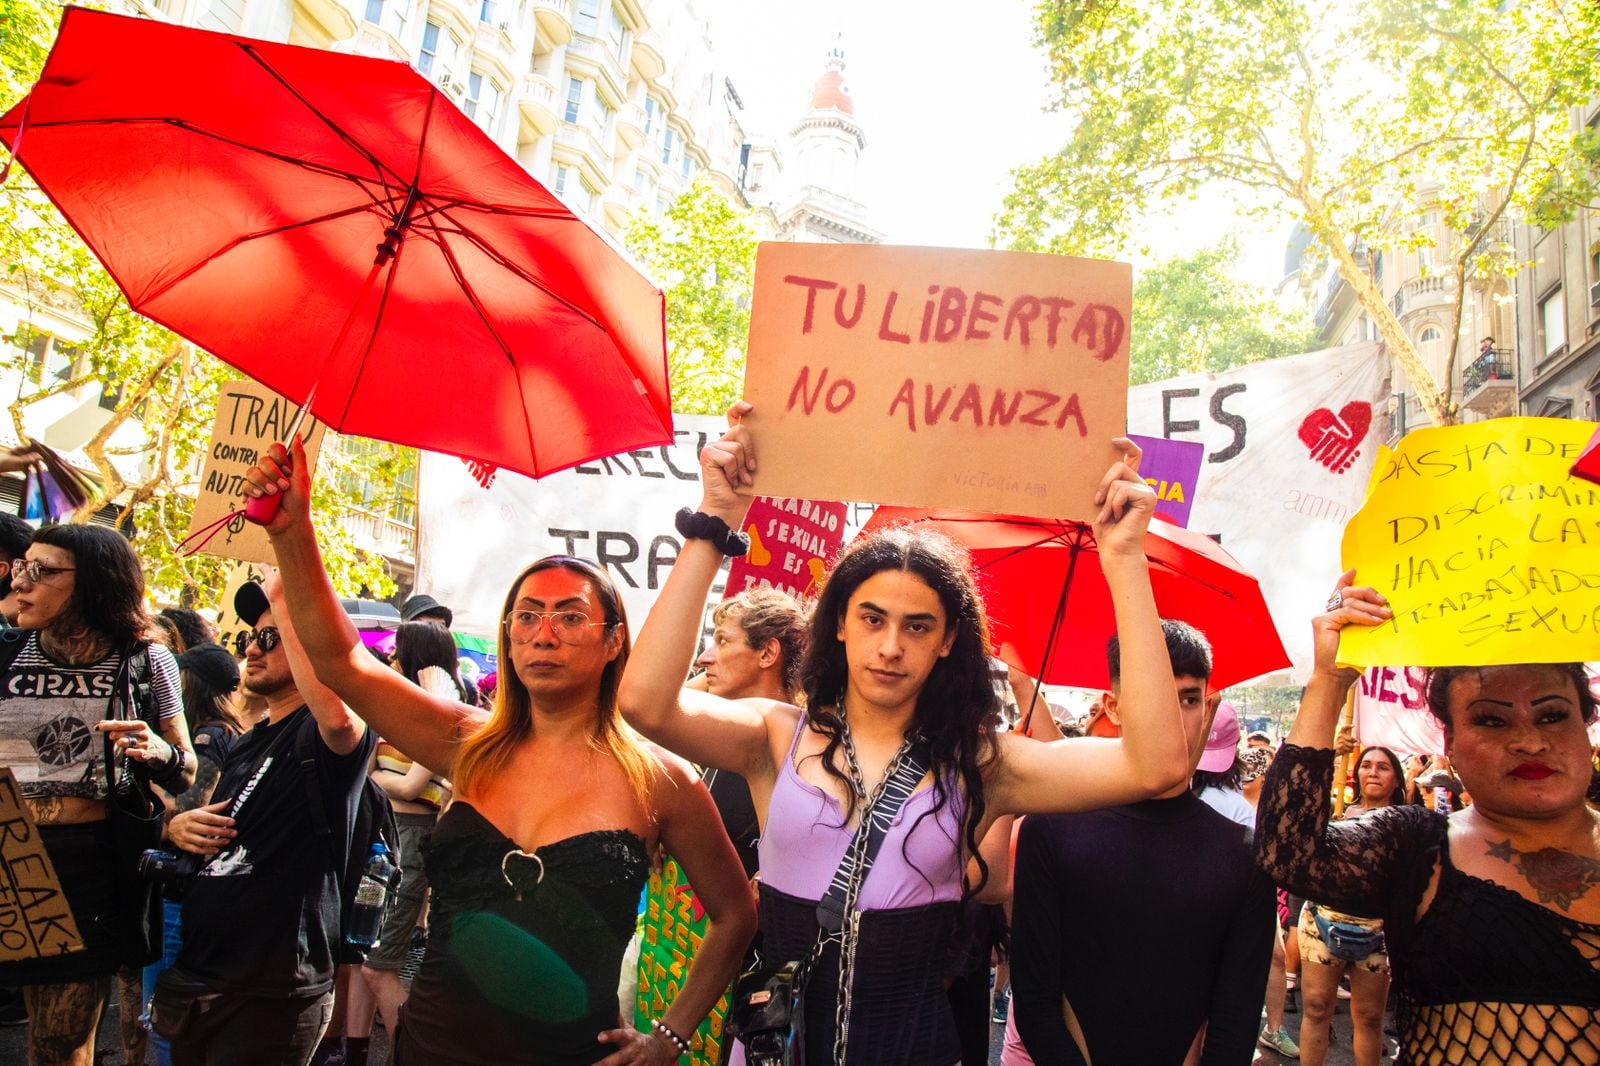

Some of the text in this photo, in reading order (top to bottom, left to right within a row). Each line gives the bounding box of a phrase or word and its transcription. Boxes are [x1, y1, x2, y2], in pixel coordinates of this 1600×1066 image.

[784, 274, 866, 335] TU
[786, 366, 1088, 438] NO AVANZA
[213, 442, 258, 466] CONTRA
[766, 518, 827, 559] SEXUAL
[1529, 513, 1600, 544] LA
[783, 551, 804, 574] ES
[8, 673, 134, 696] CRAS
